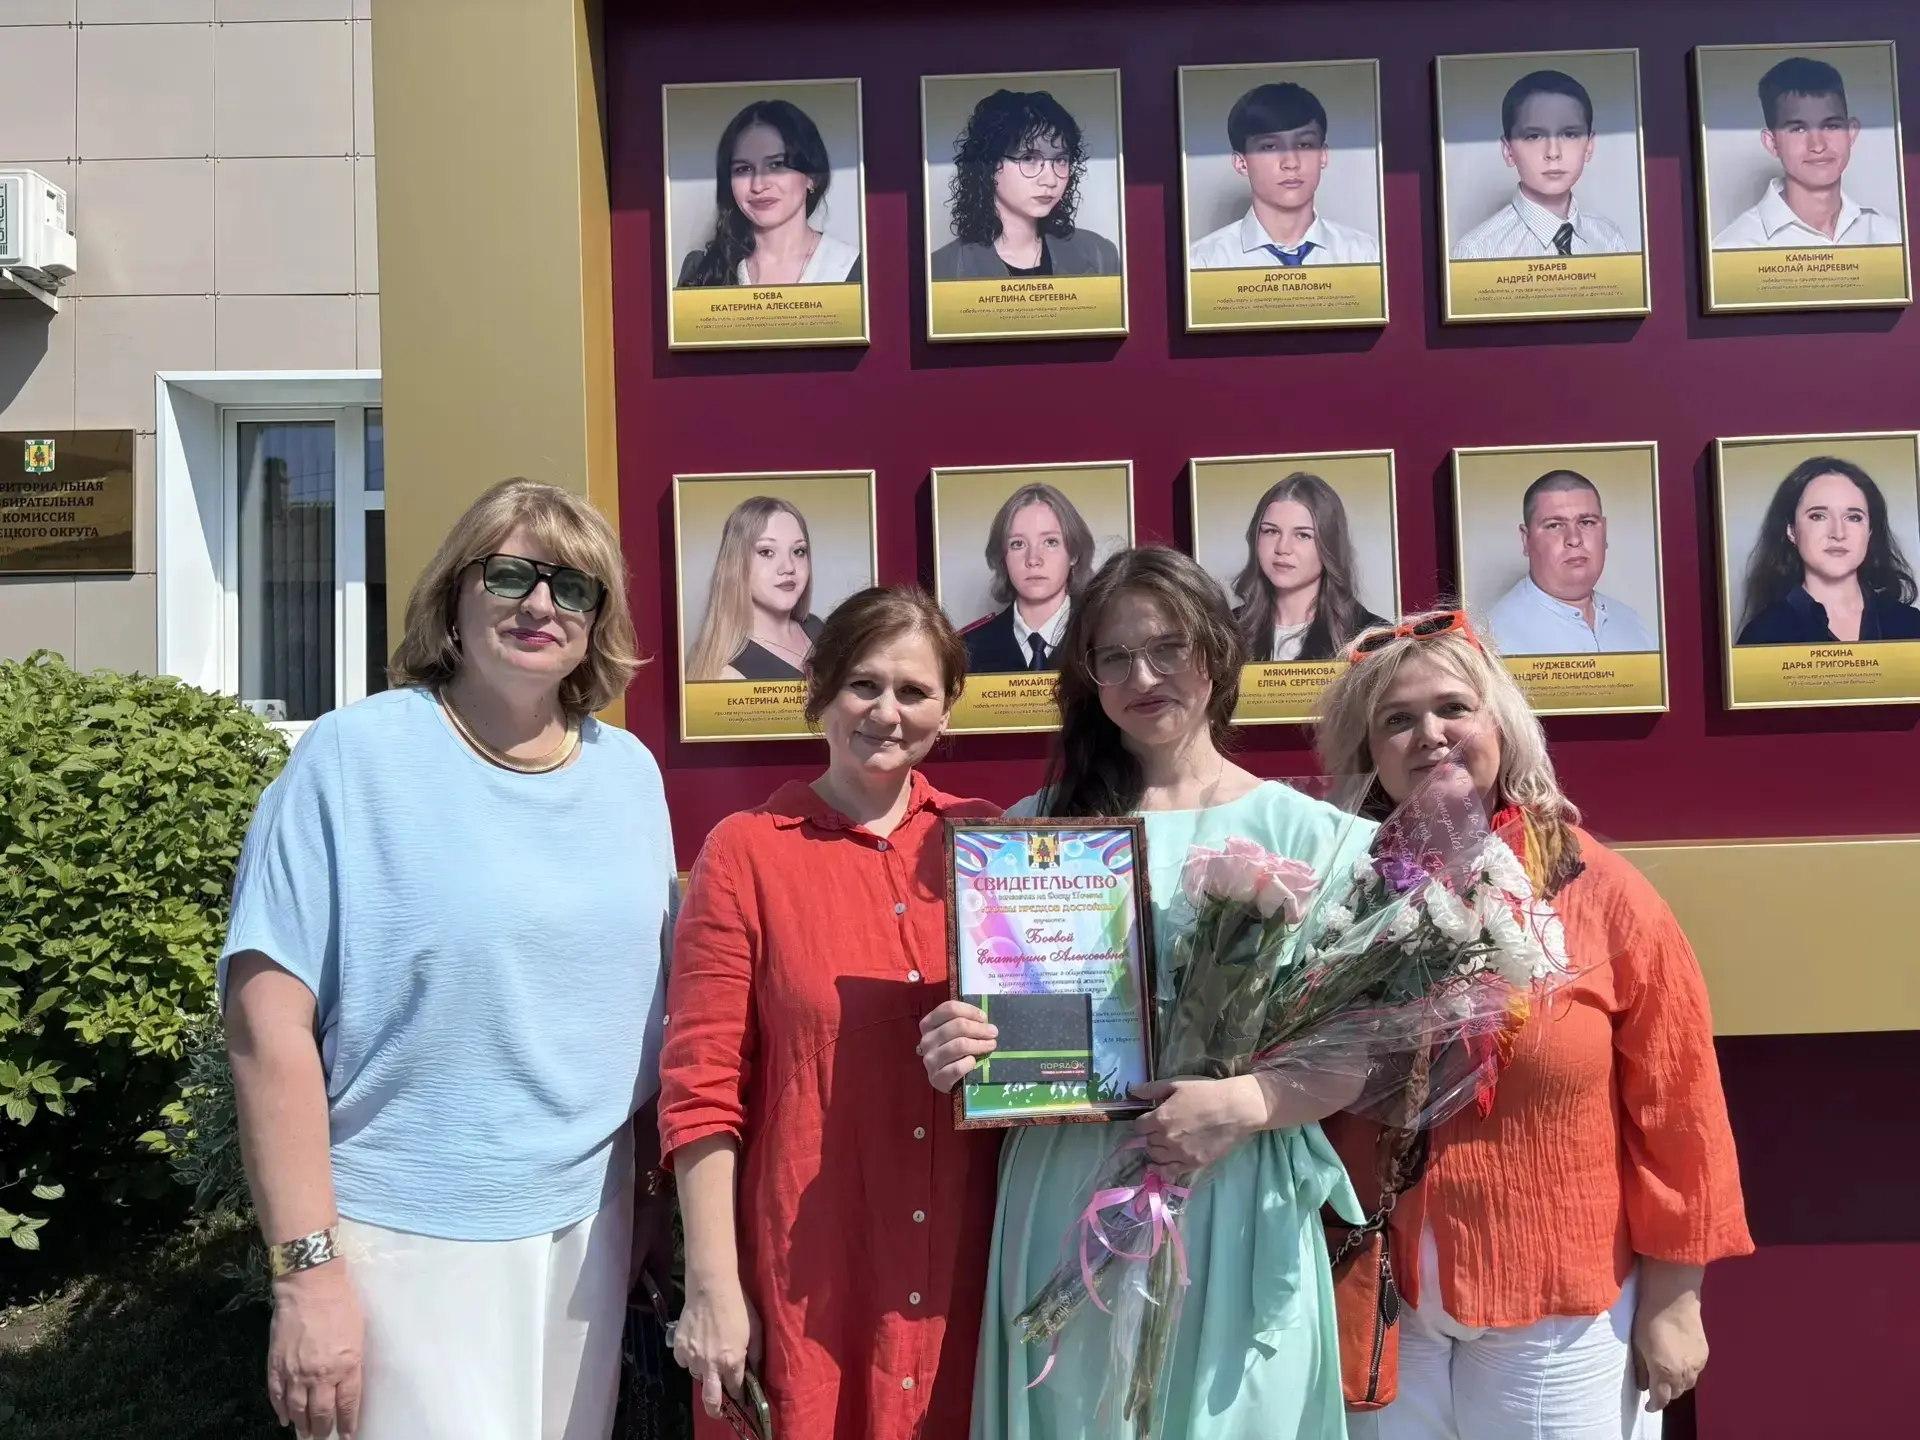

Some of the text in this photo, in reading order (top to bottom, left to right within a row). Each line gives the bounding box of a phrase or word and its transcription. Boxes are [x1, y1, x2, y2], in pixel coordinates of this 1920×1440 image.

[1786, 253, 1834, 262] КАМЫНИН
[1527, 263, 1567, 272] ЗУБАРЕВ
[1758, 262, 1859, 273] НИКОЛАЙ АНДРЕЕВИЧ
[1264, 273, 1307, 282] ДОРОГОВ
[1496, 273, 1596, 284] АНДРЕЙ РОМАНОВИЧ
[1000, 283, 1054, 292] ВАСИЛЬЕВА
[1237, 282, 1332, 293] ЯРОСЛАВ ПАВЛОВИЧ
[753, 292, 783, 300] БОЕВА
[979, 293, 1078, 304] АНГЕЛИНА СЕРГЕЕВНА
[711, 301, 823, 312] ЕКАТЕРИНА АЛЕКСЕЕВНА
[3, 512, 75, 523] КОМИССИЯ
[50, 527, 99, 538] ОКРУГА
[1810, 649, 1853, 658] РЯСКИНА
[1532, 659, 1596, 670] НУДЖЕВСКИЙ
[1782, 659, 1879, 670] ДАРЬЯ ГРИГОРЬЕВНА
[1263, 667, 1336, 677] МЯКИННИКОВА
[1551, 670, 1615, 680] ЛЕОНИДОВИЧ
[1257, 679, 1287, 688] ЕЛЕНА
[753, 685, 808, 695] МЕРКУЛОВА
[981, 689, 1016, 699] КСЕНИЯ
[727, 697, 780, 706] ЕКАТЕРИНА
[973, 875, 1117, 892] СВИДЕТЕЛЬСТВО
[1025, 928, 1074, 944] Боевой
[977, 946, 1125, 968] Екатерине Алексеевне
[1040, 1060, 1085, 1070] ПОРЯДОК
